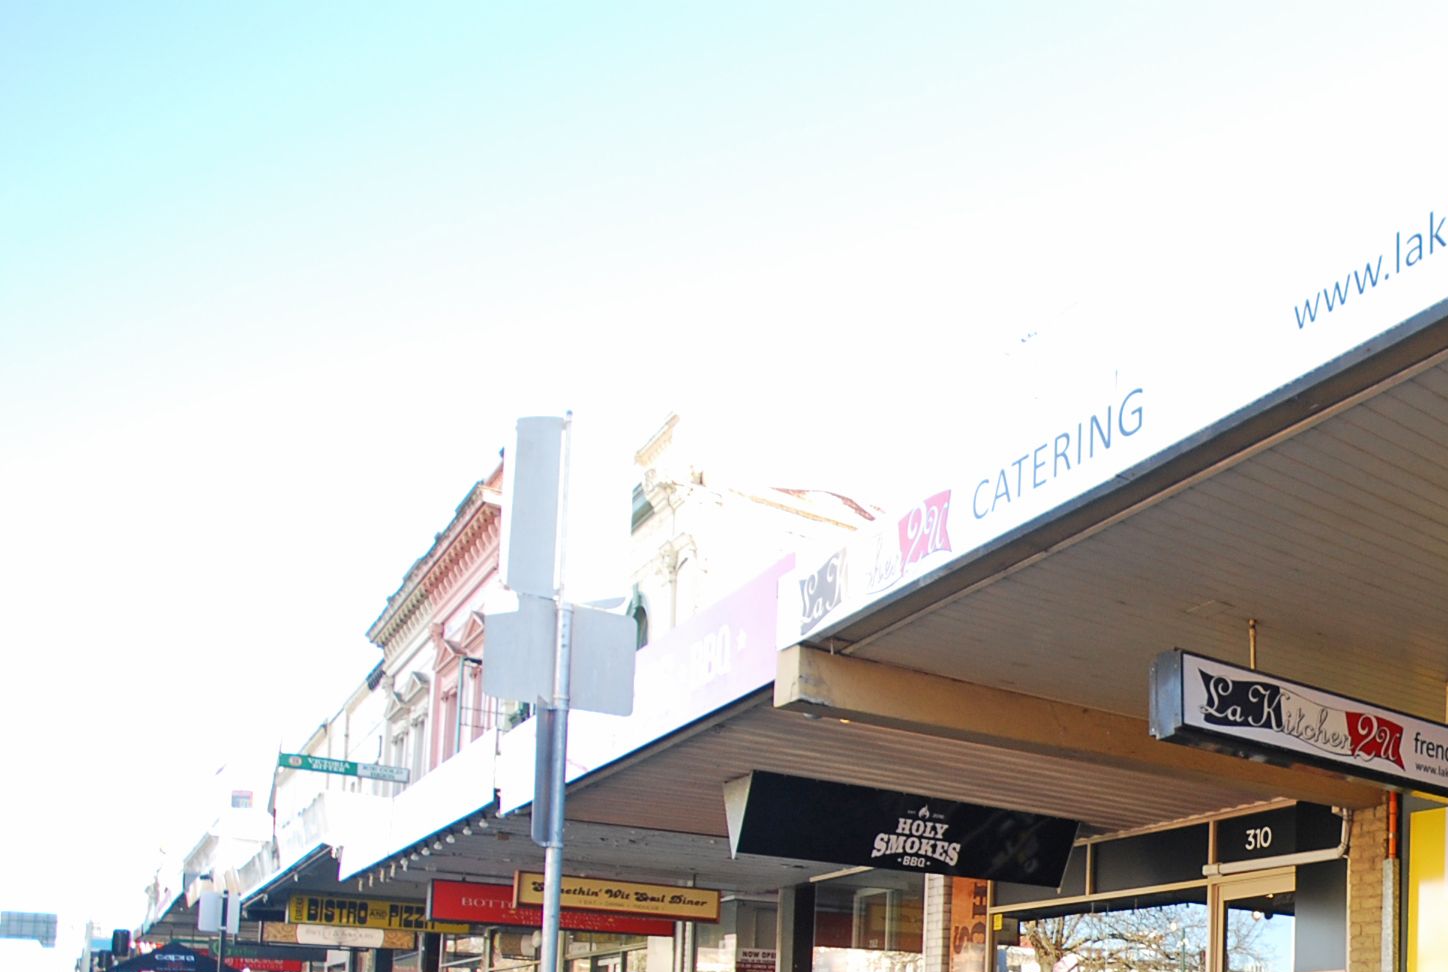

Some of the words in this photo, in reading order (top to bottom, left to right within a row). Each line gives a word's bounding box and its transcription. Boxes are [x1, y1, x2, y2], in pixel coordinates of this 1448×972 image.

[972, 387, 1144, 520] CATERING
[1199, 674, 1244, 719] La
[1247, 685, 1354, 753] Kitchen
[896, 817, 949, 839] HOLY
[1245, 826, 1272, 850] 310
[871, 832, 961, 867] SMOKES
[902, 855, 926, 868] BBQ
[308, 899, 369, 925] BISTRO
[668, 894, 708, 908] Diner
